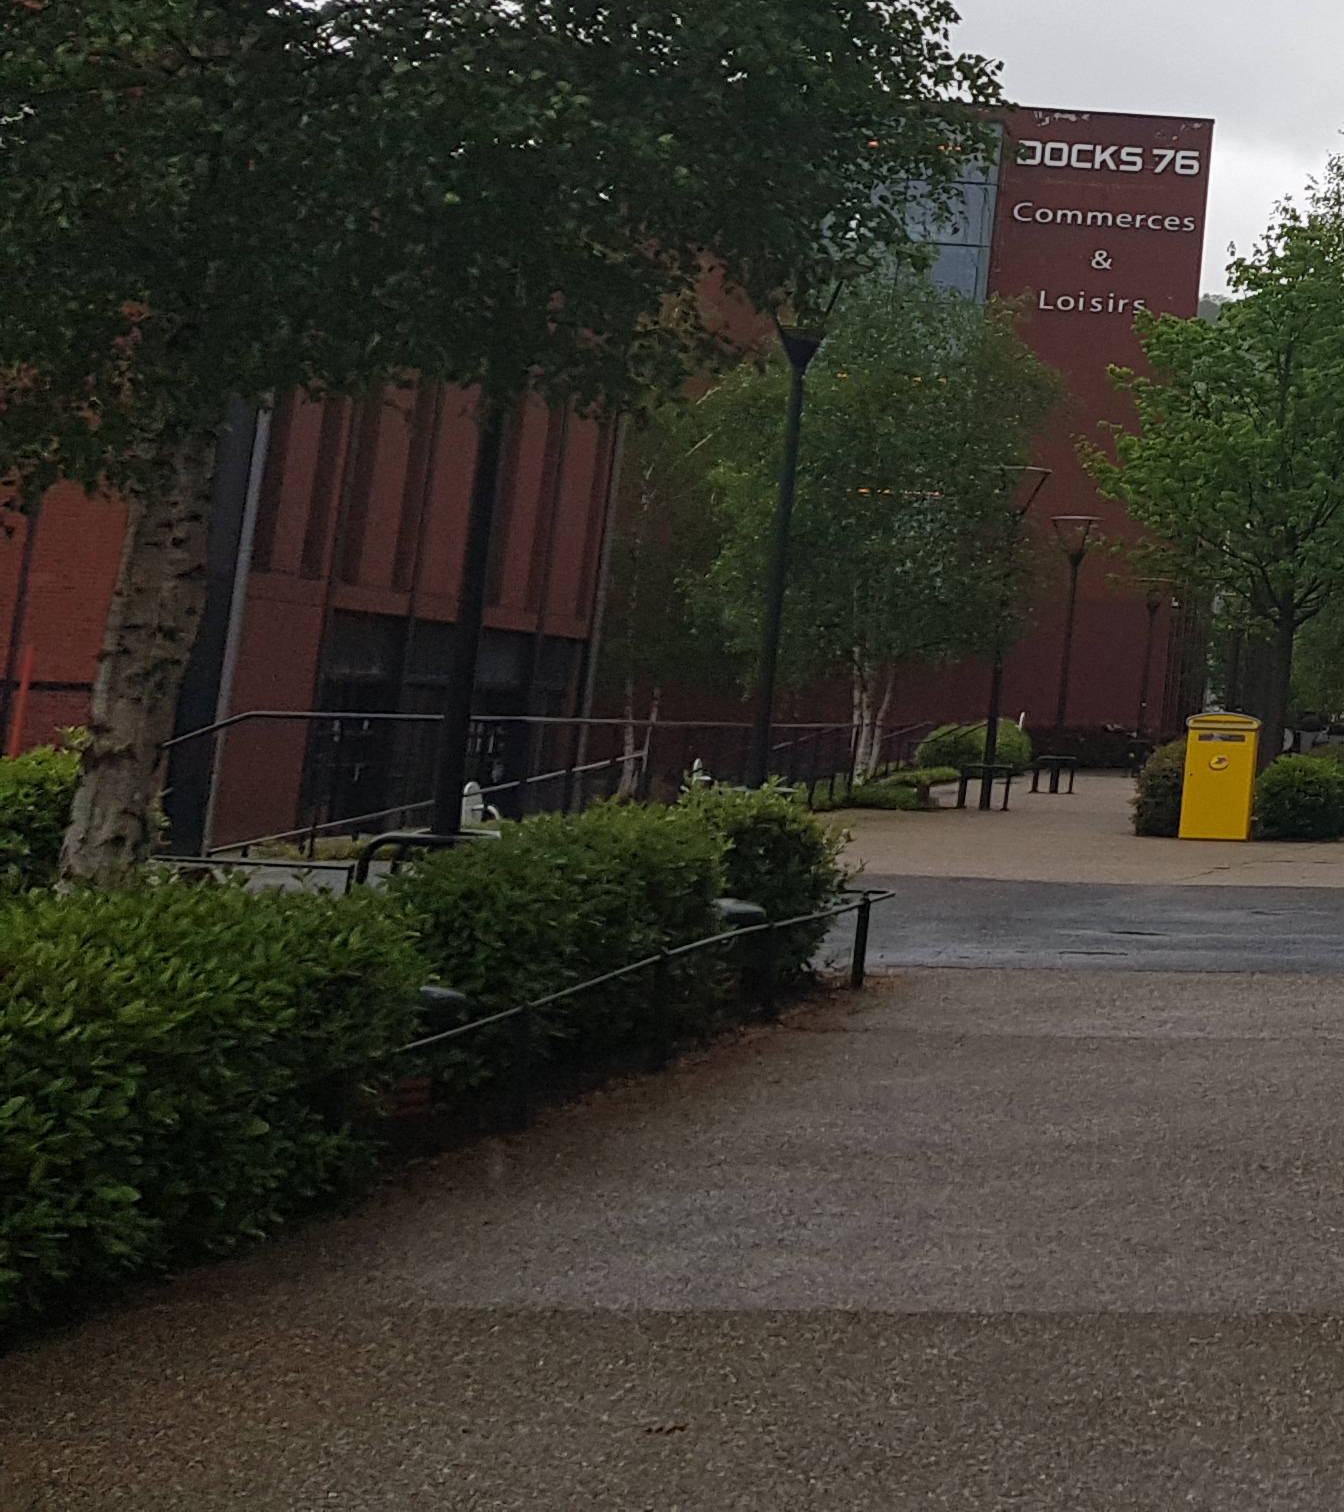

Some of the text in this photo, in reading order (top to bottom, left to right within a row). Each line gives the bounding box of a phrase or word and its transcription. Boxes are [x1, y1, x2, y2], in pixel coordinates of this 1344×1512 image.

[1152, 148, 1200, 175] 76
[1012, 201, 1196, 232] Commerces
[1090, 249, 1113, 271] &
[1038, 289, 1147, 316] Loisirs
